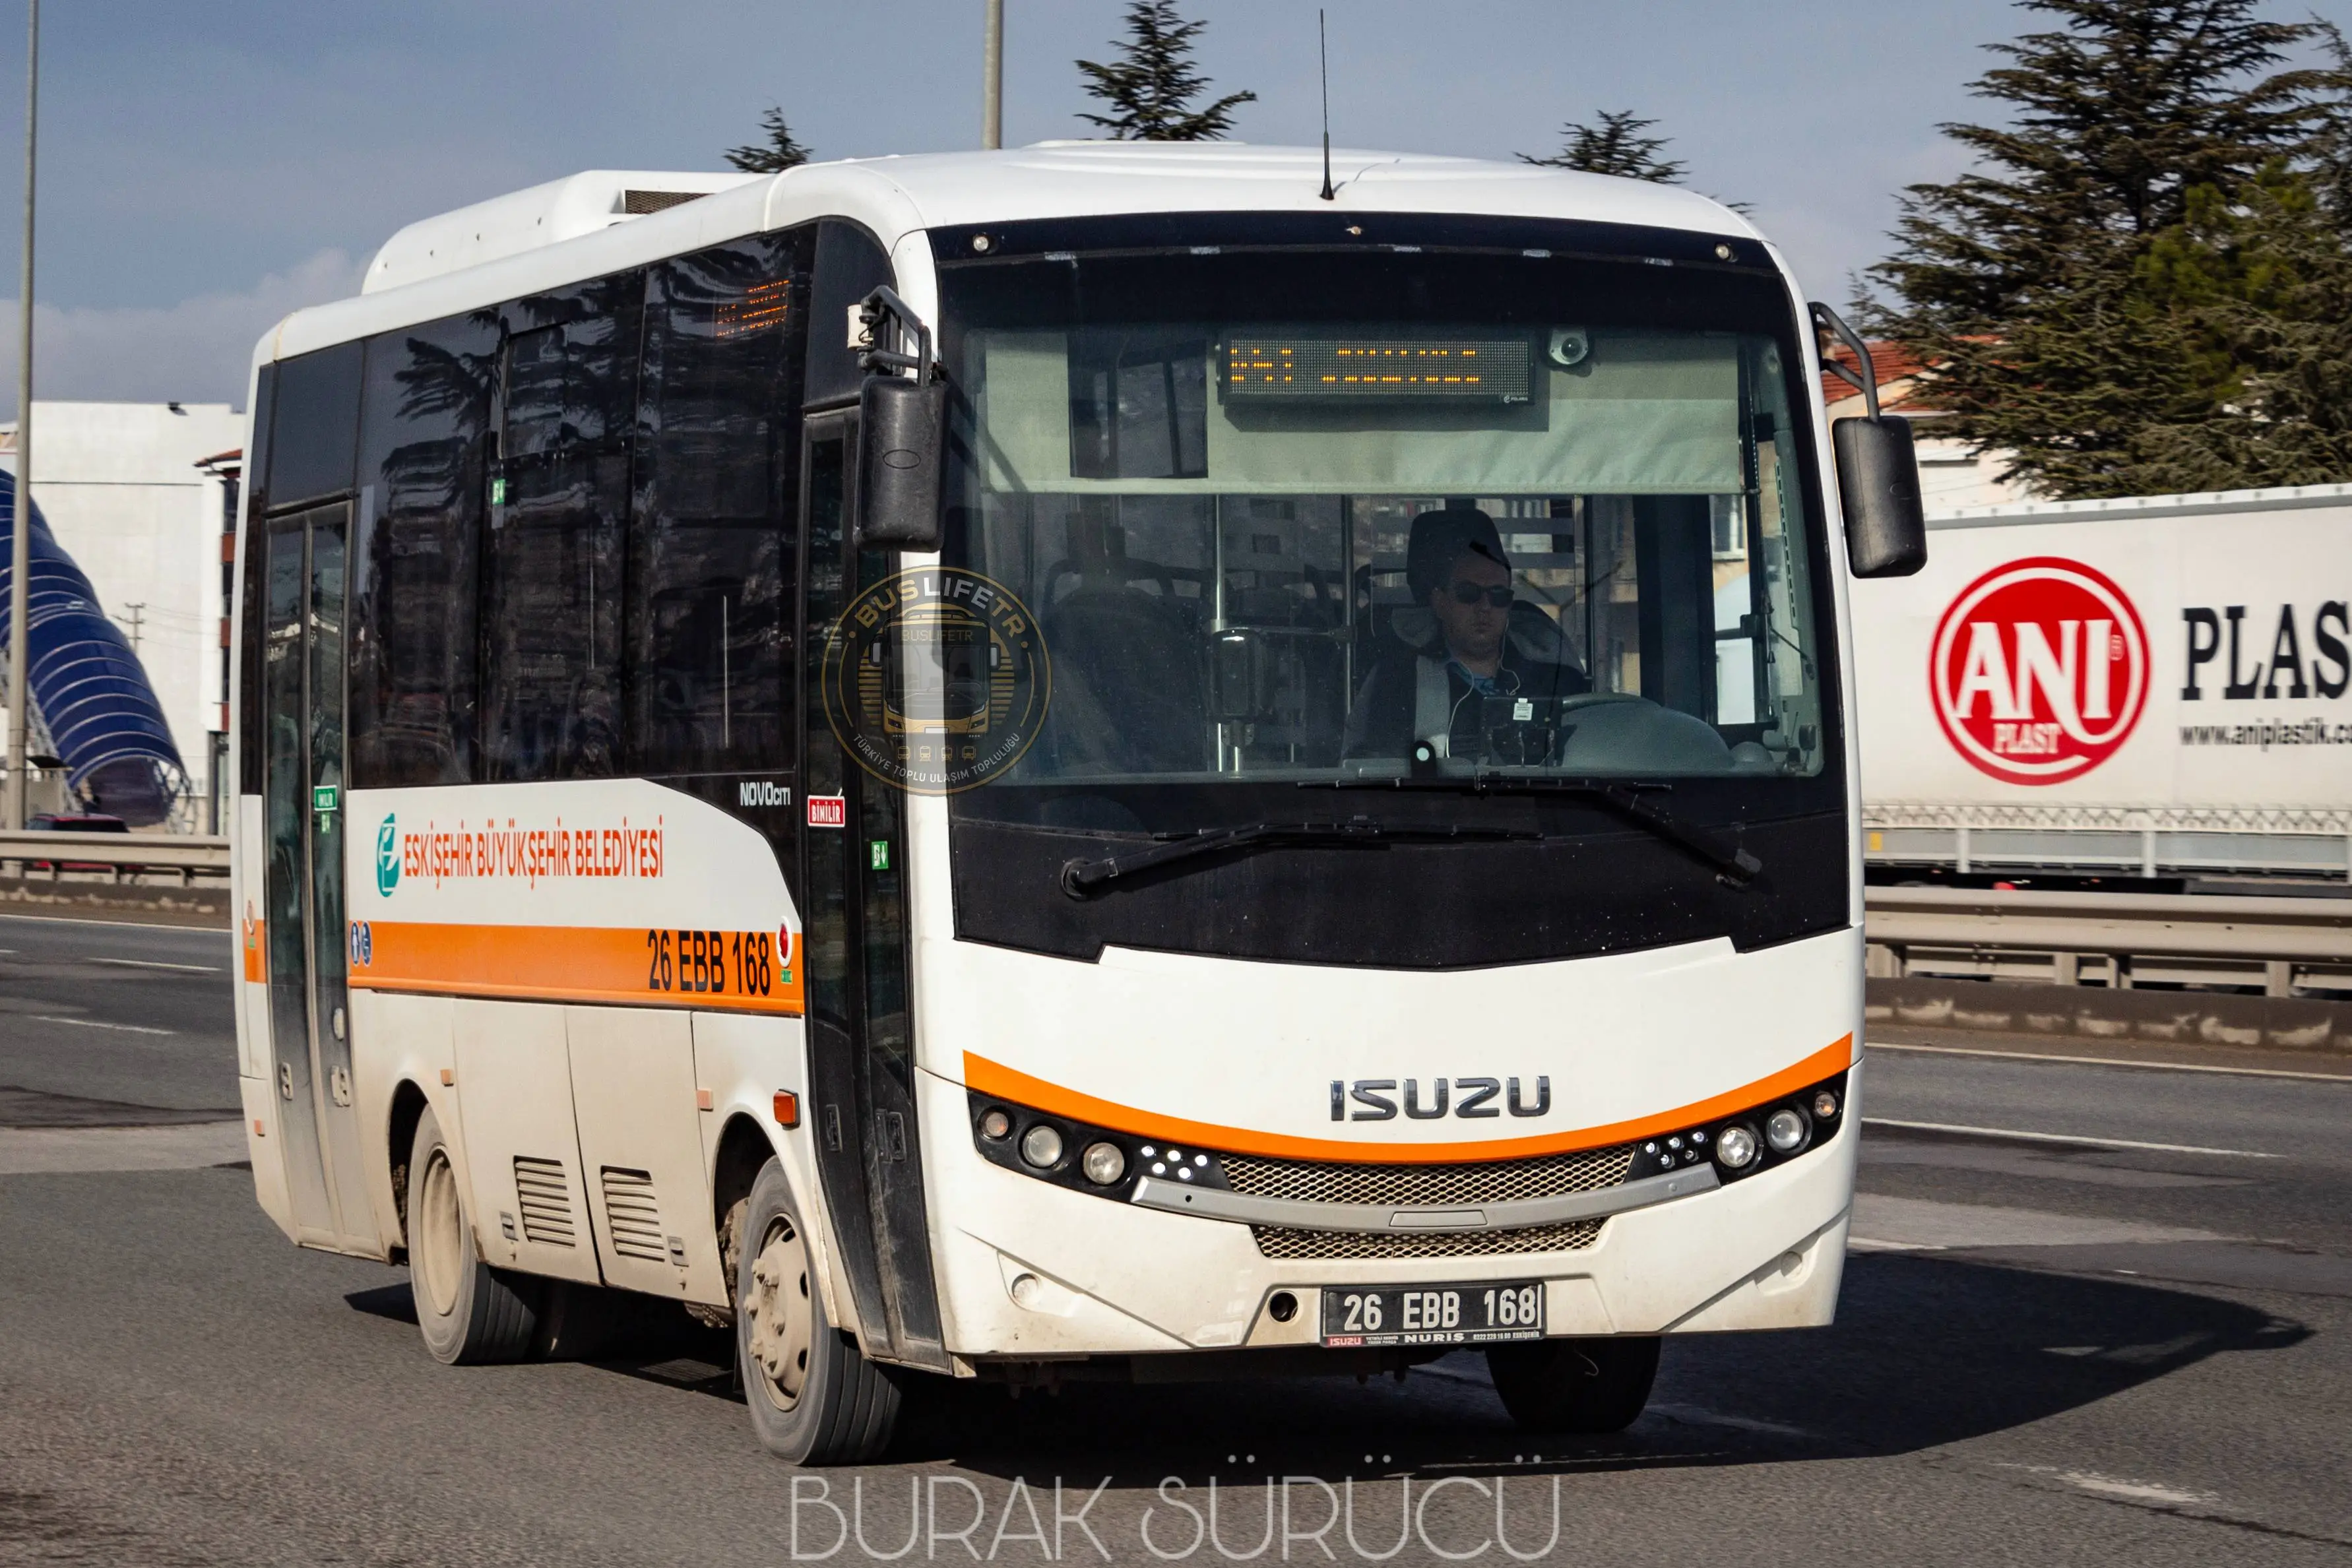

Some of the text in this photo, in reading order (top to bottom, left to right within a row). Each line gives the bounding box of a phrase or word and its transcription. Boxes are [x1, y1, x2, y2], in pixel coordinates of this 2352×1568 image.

[1954, 619, 2114, 719] ANI
[2181, 600, 2351, 701] PLAS
[1993, 723, 2062, 754] PLAST
[2179, 716, 2352, 753] www.aniplastik.c
[811, 801, 841, 823] BİNİLİR
[404, 814, 663, 891] ESKİŞEHİR BÜYÜKŞEHİR BELEDİYESİ
[648, 929, 771, 996] 26 EBB 168
[1330, 1075, 1550, 1121] ISUZU
[1344, 1288, 1537, 1331] 26 EBB 168
[1330, 1336, 1361, 1346] ISUZU
